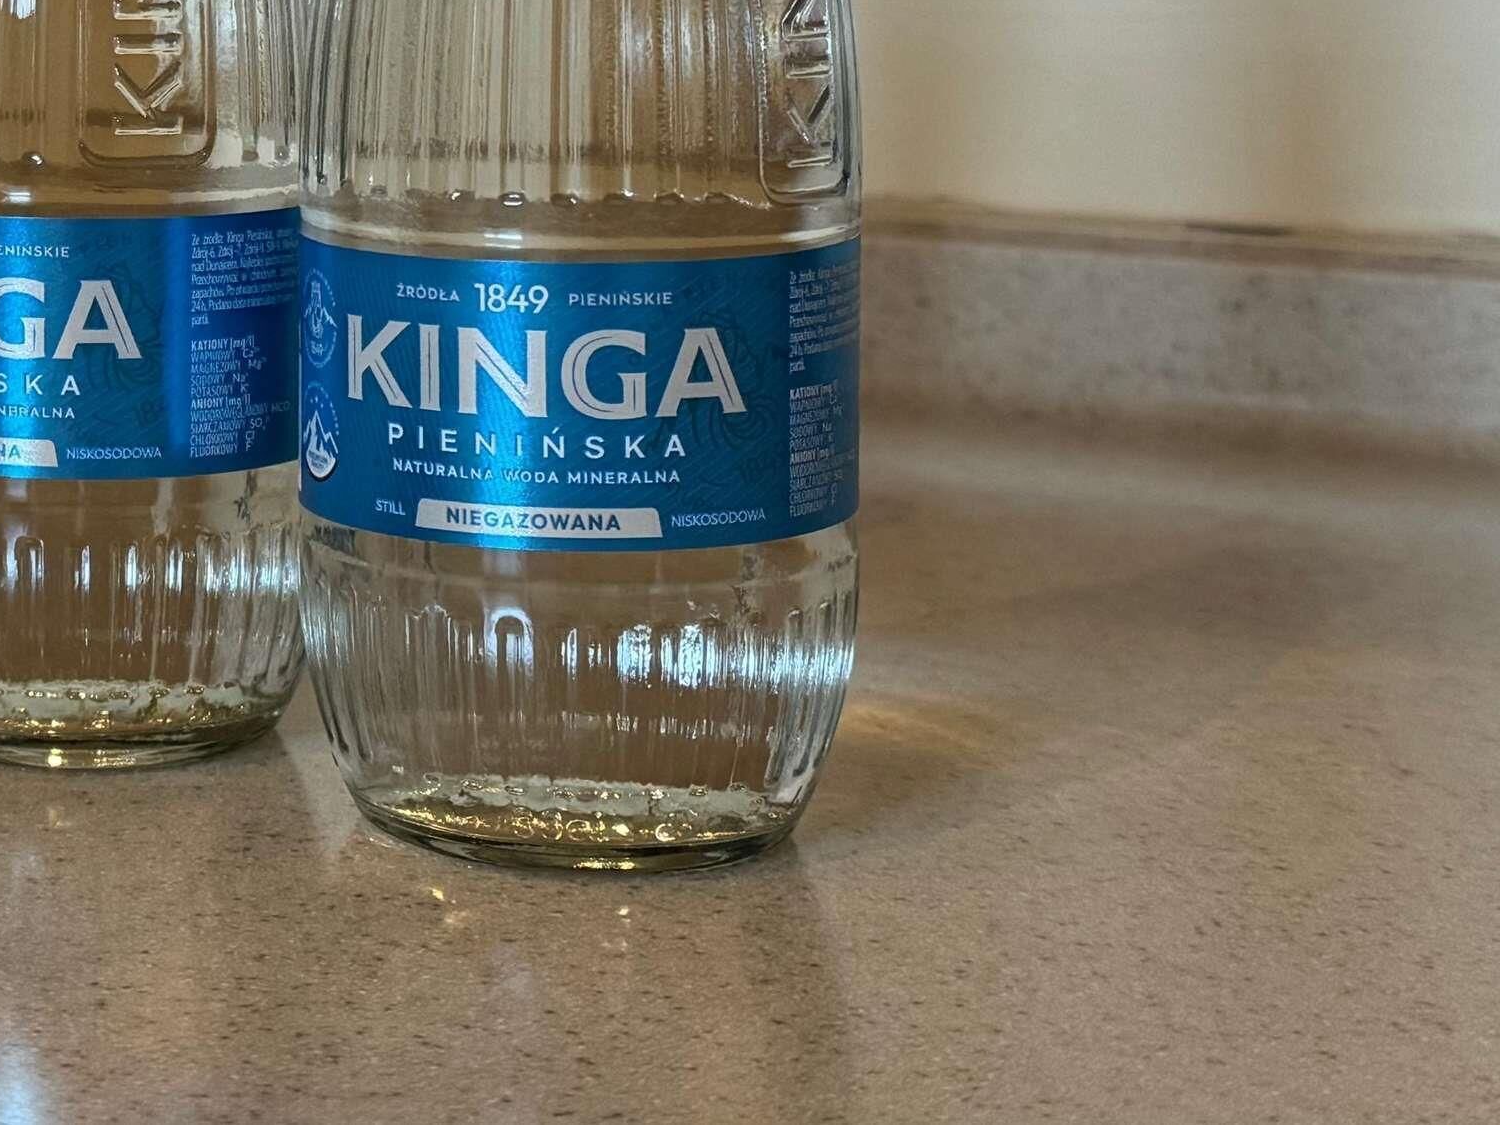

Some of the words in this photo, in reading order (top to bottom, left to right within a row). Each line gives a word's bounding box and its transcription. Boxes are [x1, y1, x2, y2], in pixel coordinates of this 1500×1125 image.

[396, 282, 461, 302] ŹRÓDŁA
[474, 283, 549, 314] 1849
[568, 290, 673, 307] PIENIŃSKIE
[346, 313, 747, 420] KINGA
[65, 446, 163, 460] NISKOSODOWA
[387, 422, 686, 460] PIENIŃSKA
[392, 457, 494, 481] NATURALNA
[503, 469, 560, 484] WODA
[567, 469, 681, 484] MINERALNA
[375, 498, 406, 515] STILL
[445, 506, 622, 532] NIEGAZOWANA
[670, 507, 767, 528] NISKOSODOWA
